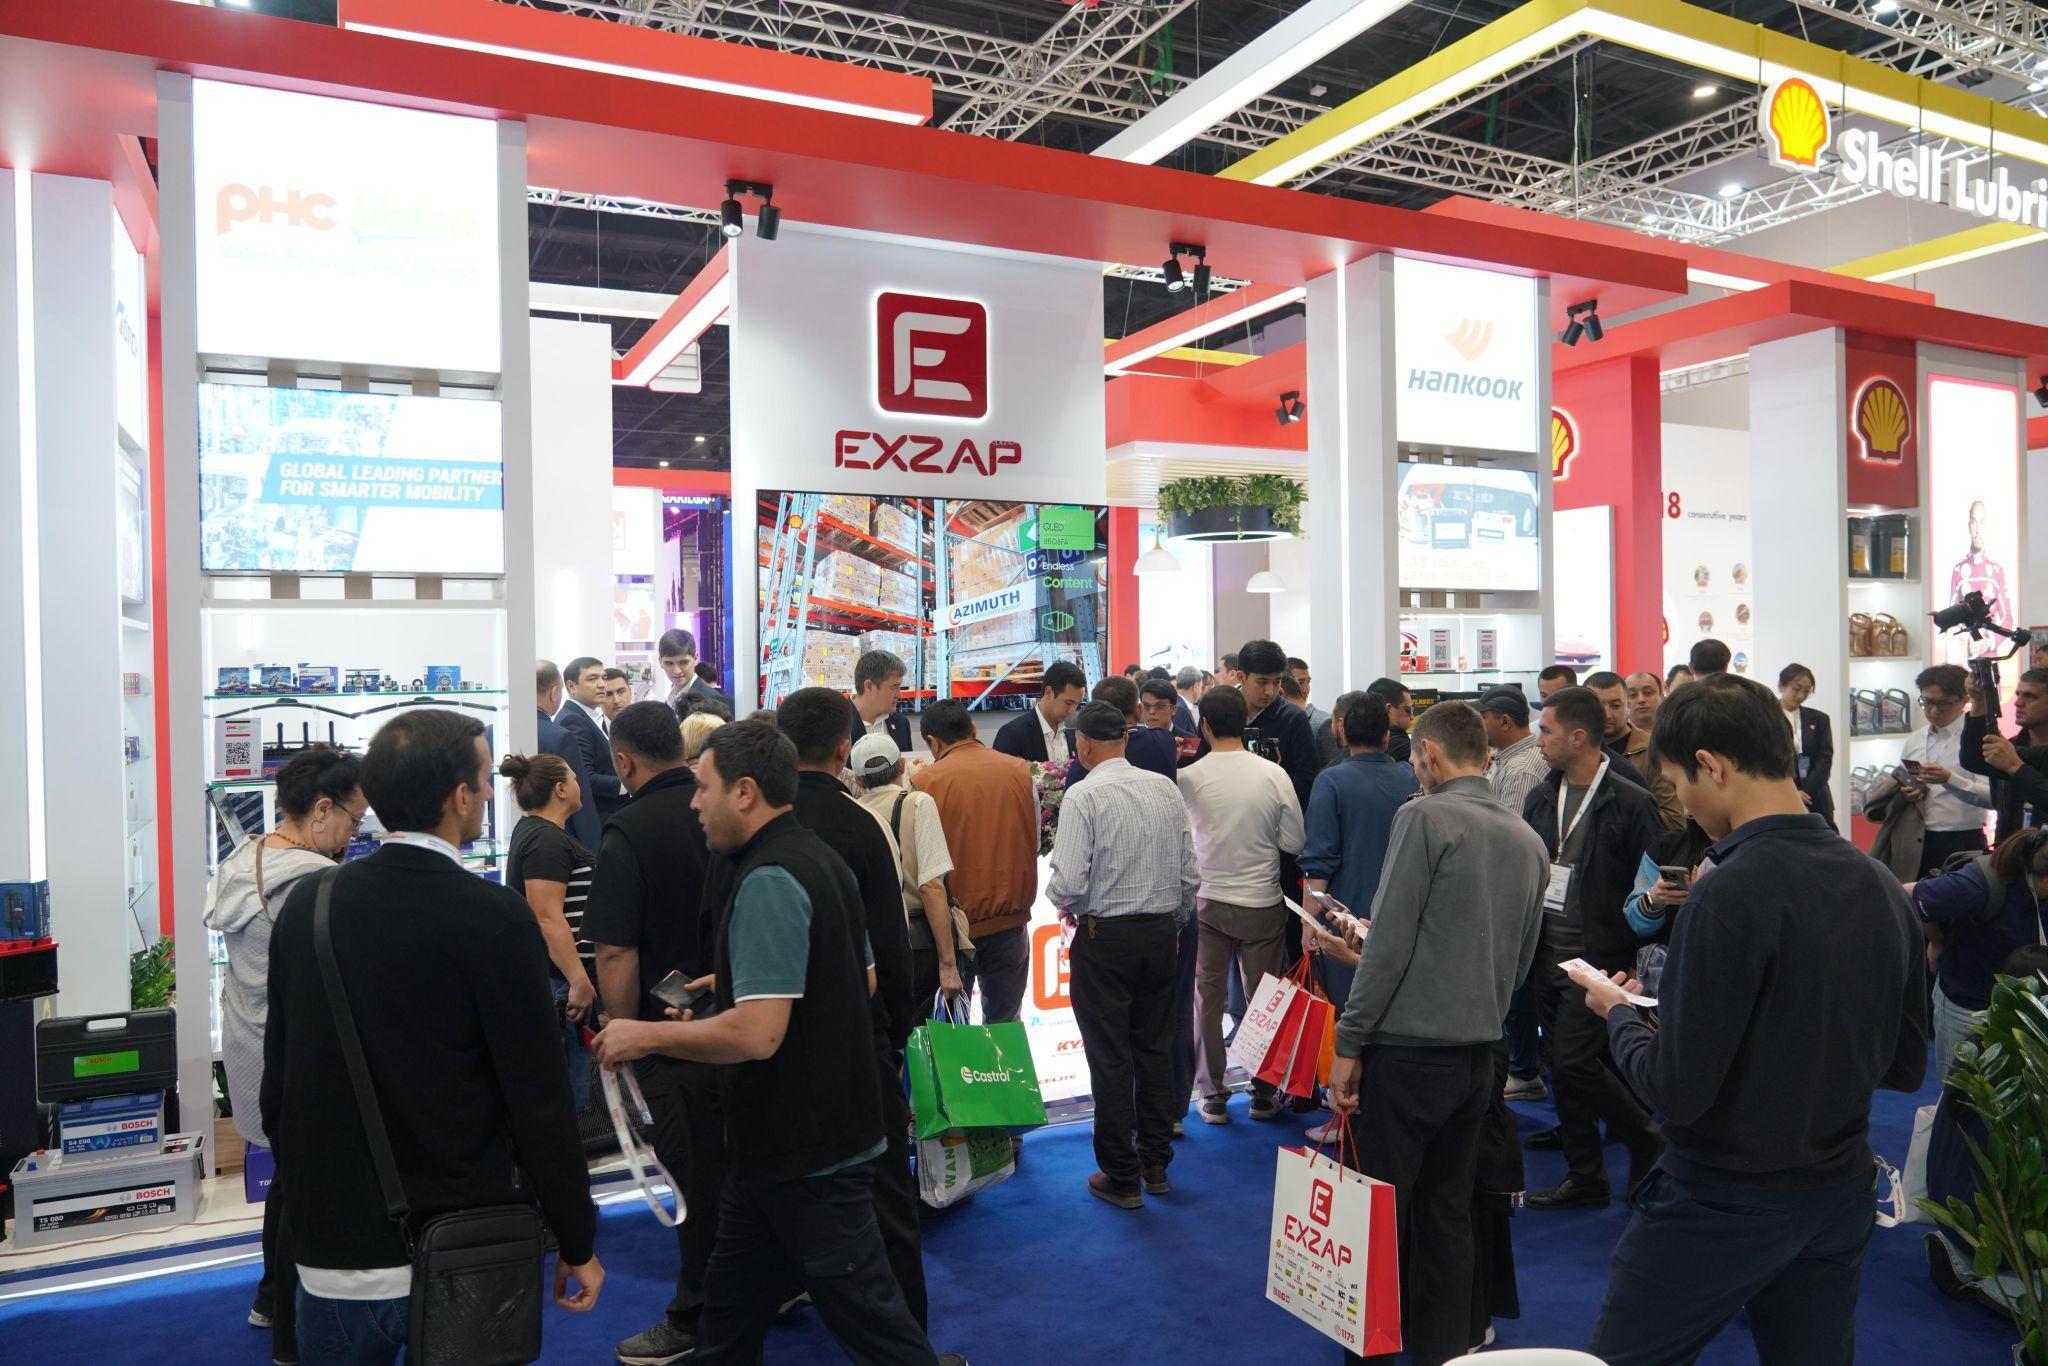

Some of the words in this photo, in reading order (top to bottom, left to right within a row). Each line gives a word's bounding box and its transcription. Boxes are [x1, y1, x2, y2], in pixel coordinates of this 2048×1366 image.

[1838, 127, 1942, 204] Shell
[1950, 159, 2047, 229] Lubri
[835, 429, 1022, 477] EXZAP
[280, 462, 347, 480] GLOBAL
[351, 465, 424, 481] LEADING
[428, 467, 502, 485] PARTNER
[280, 480, 316, 497] FOR
[319, 482, 401, 499] SMARTER
[405, 484, 486, 501] MOBILITY
[1687, 511, 1726, 520] consecutive
[1729, 513, 1748, 523] years
[1043, 522, 1065, 532] QLED
[1042, 561, 1075, 571] Endless
[1042, 575, 1094, 588] Content
[953, 590, 1020, 620] AZIMUTH
[1248, 1008, 1279, 1033] EXZAP
[972, 1069, 1011, 1082] Castrol
[121, 1119, 153, 1130] BOSCH
[135, 1188, 171, 1200] BOSCH
[1284, 1214, 1352, 1268] EXZAP
